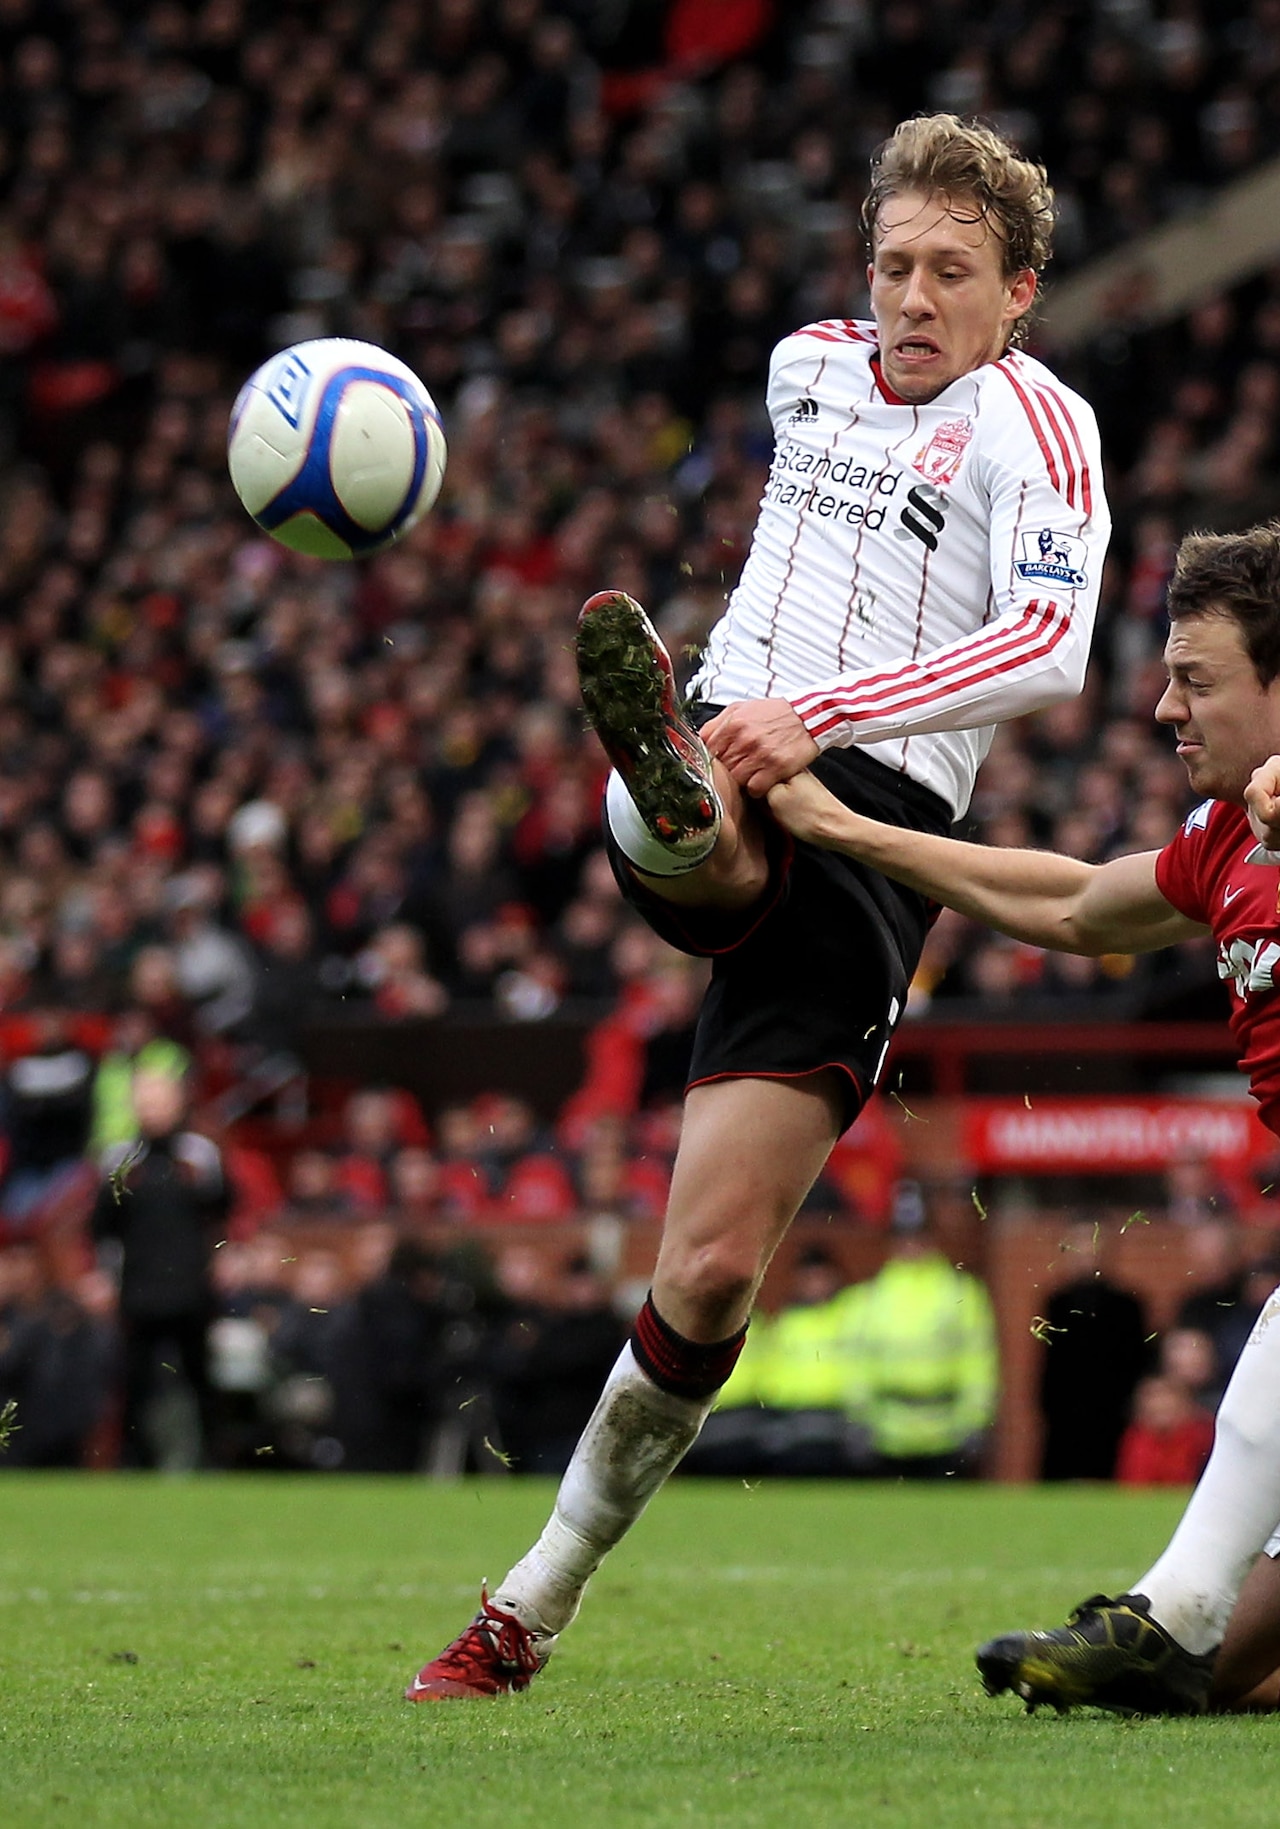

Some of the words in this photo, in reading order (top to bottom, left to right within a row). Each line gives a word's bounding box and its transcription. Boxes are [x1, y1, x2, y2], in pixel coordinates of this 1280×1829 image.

[776, 445, 904, 496] Standard
[769, 475, 888, 531] hartered
[1025, 564, 1071, 577] BARCLAYS
